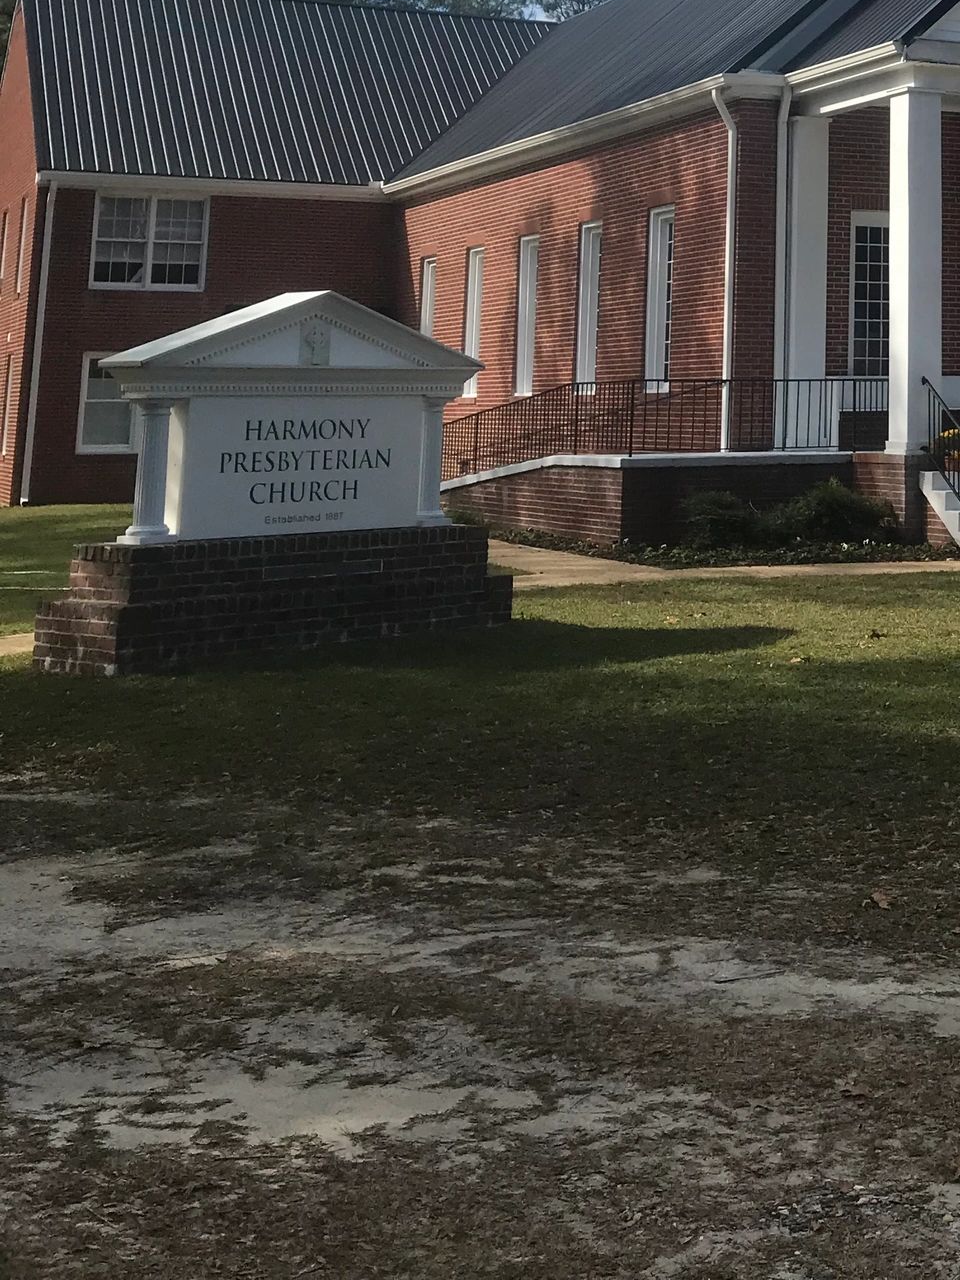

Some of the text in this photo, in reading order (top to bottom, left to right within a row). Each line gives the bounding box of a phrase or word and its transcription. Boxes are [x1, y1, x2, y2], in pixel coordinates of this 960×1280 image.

[244, 418, 371, 441] HARMONY
[219, 448, 392, 474] PRESBYTERIAN
[249, 479, 359, 505] CHURCH
